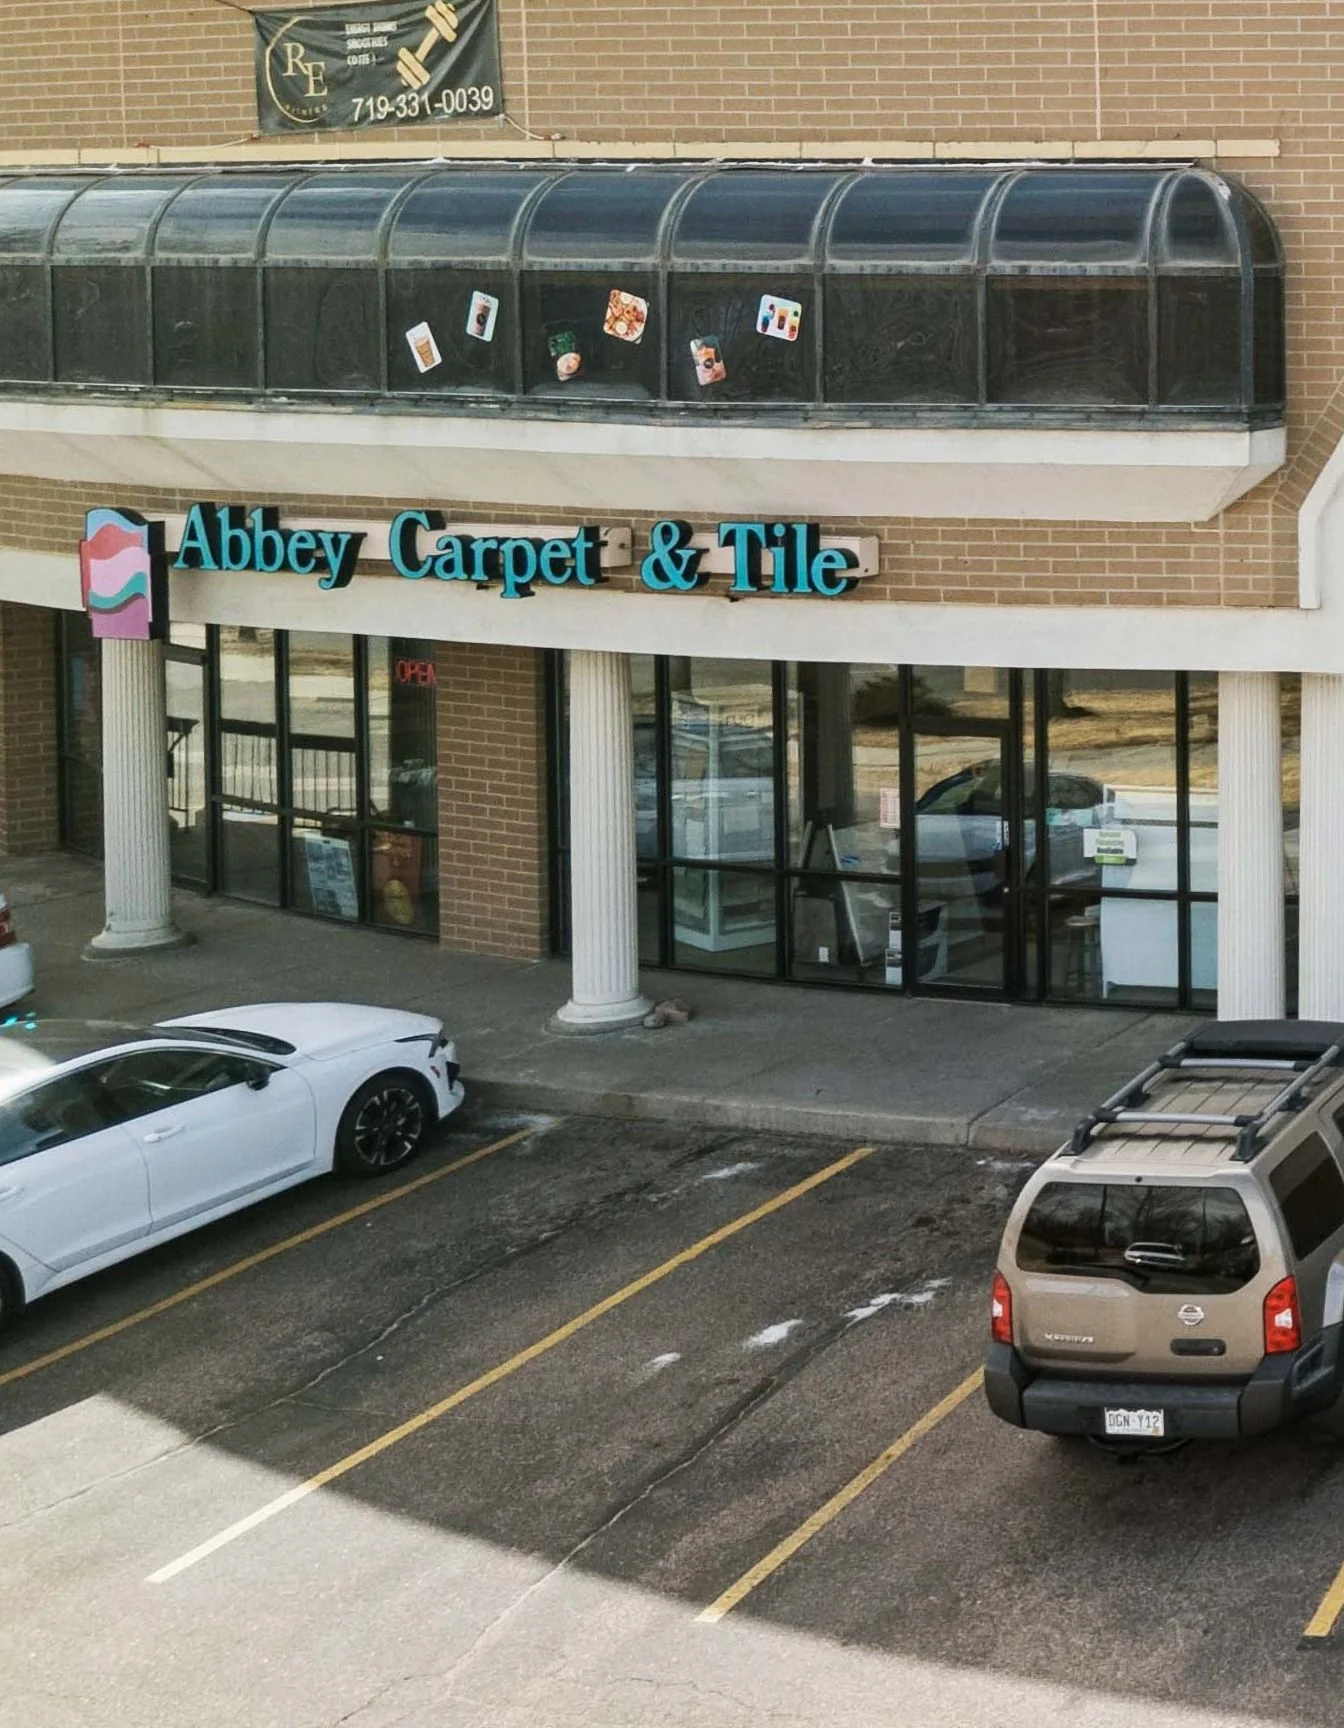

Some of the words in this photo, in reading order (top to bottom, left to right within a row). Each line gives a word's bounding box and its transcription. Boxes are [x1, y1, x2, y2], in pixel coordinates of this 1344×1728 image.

[351, 85, 494, 122] 719-331-0039
[174, 503, 359, 590] Abbey
[389, 510, 596, 598] Carpet
[640, 520, 706, 591] &
[717, 522, 852, 595] Tile
[396, 660, 436, 685] OPEN
